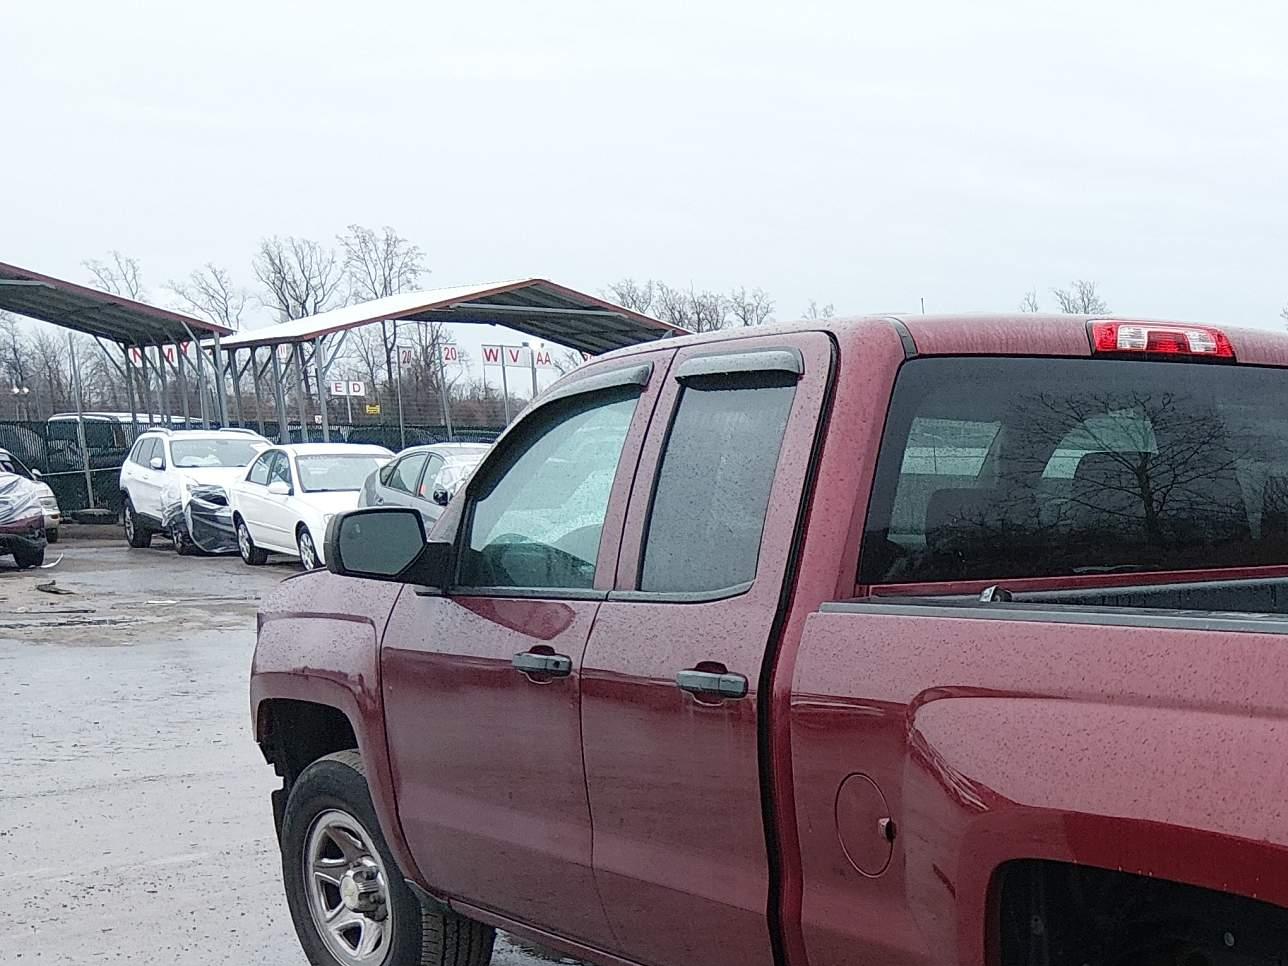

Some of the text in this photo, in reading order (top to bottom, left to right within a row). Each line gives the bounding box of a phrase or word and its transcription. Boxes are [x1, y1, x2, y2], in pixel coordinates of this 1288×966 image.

[401, 349, 412, 364] 20
[444, 346, 457, 361] 20
[484, 348, 520, 363] W V
[536, 351, 552, 365] AA
[334, 382, 361, 393] E D
